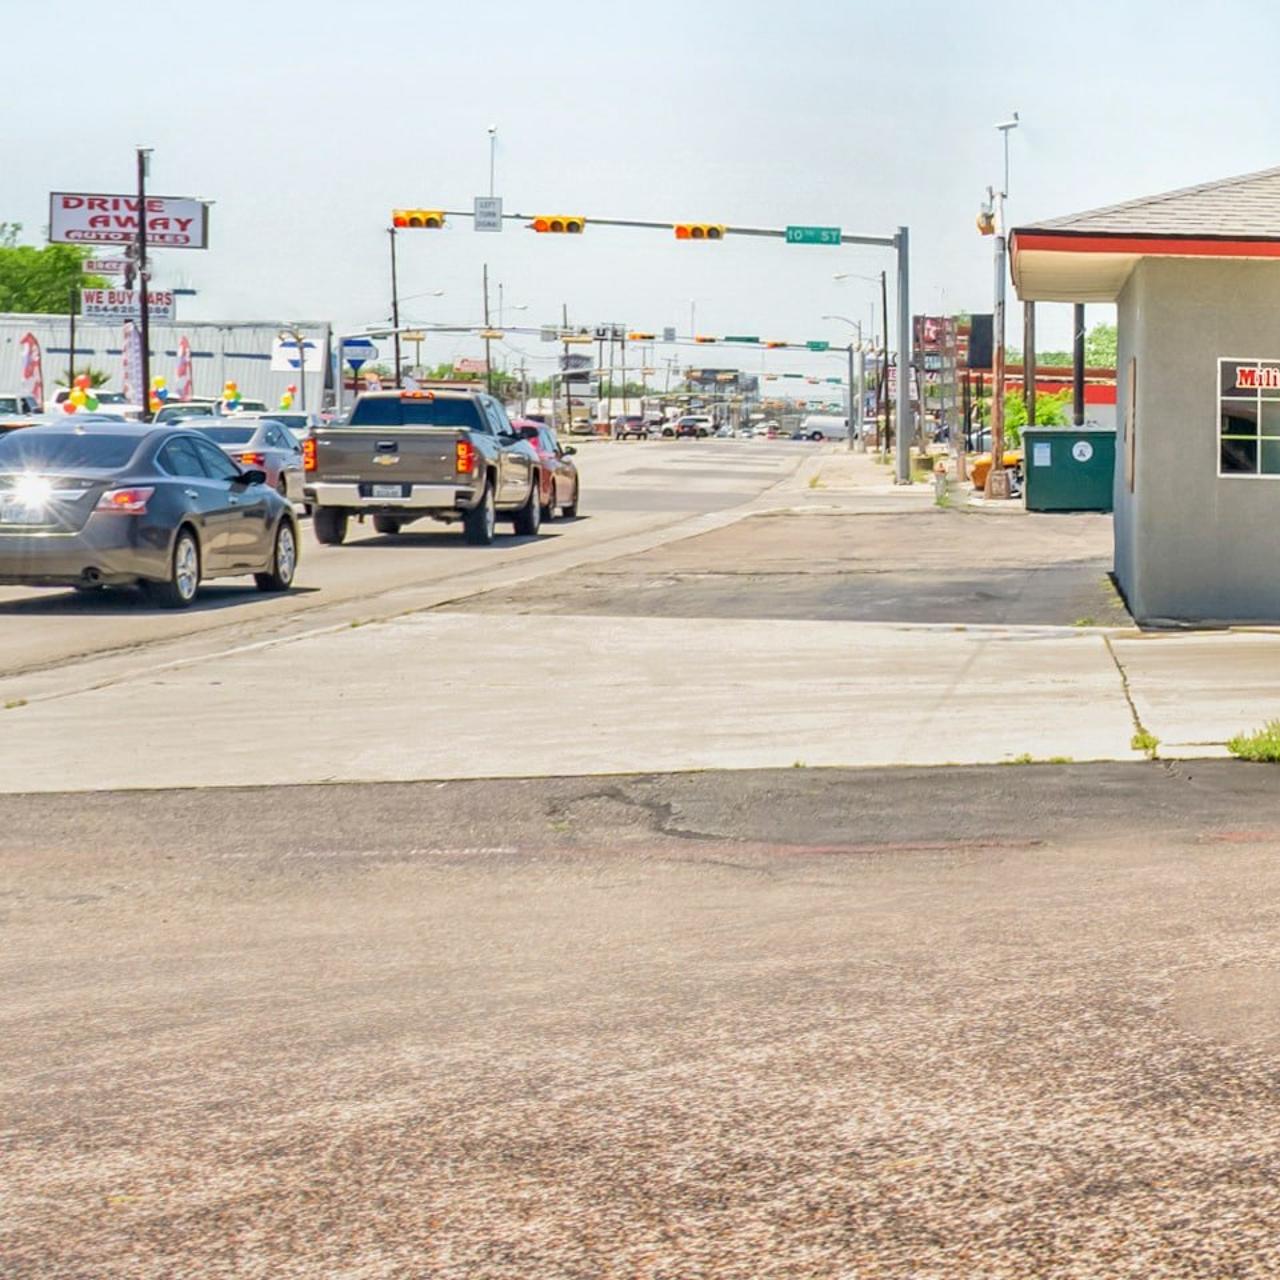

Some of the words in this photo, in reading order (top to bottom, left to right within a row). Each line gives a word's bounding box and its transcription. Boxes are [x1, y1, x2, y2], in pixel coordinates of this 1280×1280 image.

[62, 196, 165, 212] DRIVE
[88, 215, 194, 232] AWAY
[69, 230, 124, 240] AUTO
[821, 230, 838, 242] ST
[84, 291, 103, 304] WE
[108, 291, 134, 304] BUY
[139, 292, 172, 306] ARS
